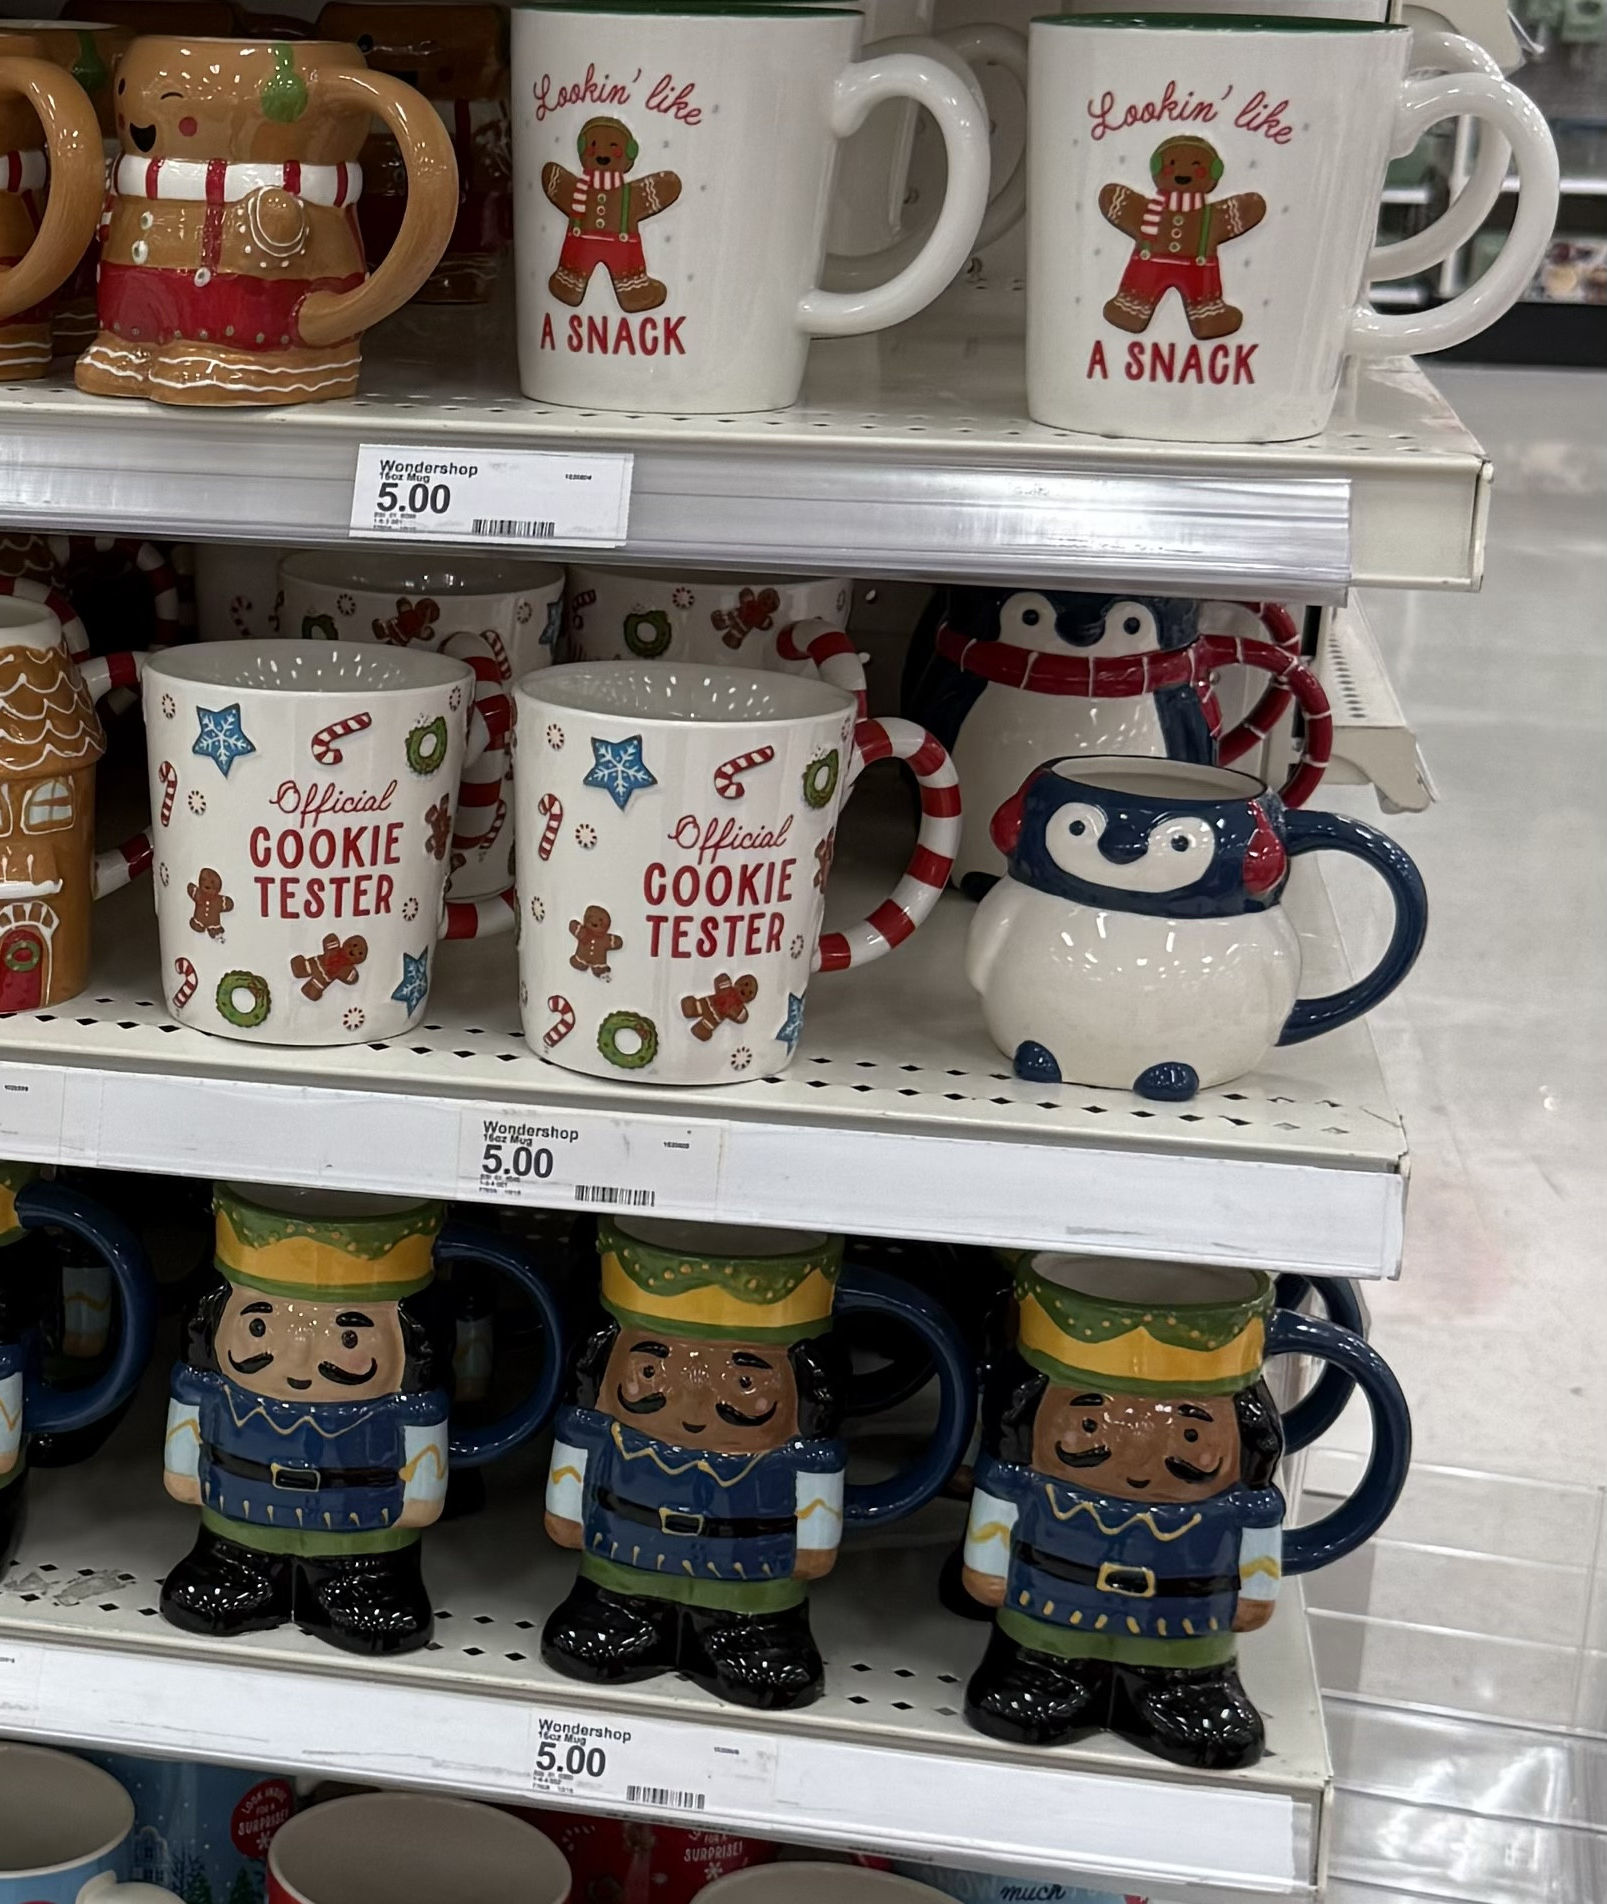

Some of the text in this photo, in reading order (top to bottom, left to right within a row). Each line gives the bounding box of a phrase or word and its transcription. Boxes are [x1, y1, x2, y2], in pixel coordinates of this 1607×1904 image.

[533, 62, 702, 125] Lookin' like
[1086, 80, 1293, 145] Lookin' like
[539, 312, 686, 356] A SNACK
[1085, 340, 1258, 385] A SNACK
[380, 459, 478, 478] Wondershop
[407, 473, 430, 484] Mug
[377, 482, 450, 514] 5.00
[269, 779, 397, 830] Official
[249, 821, 404, 869] COOKIE
[667, 814, 794, 865] Official
[254, 873, 393, 919] TESTER
[643, 858, 797, 907] COOKIE
[645, 912, 785, 958] TESTER
[482, 1120, 578, 1143] Wondershop
[509, 1136, 532, 1147] Mug
[481, 1144, 552, 1178] 5.00
[538, 1718, 631, 1744] Wondershop
[563, 1733, 585, 1746] Mug
[535, 1741, 605, 1777] 5.00
[684, 1841, 743, 1863] SURPRISE!
[1000, 1883, 1066, 1901] much
